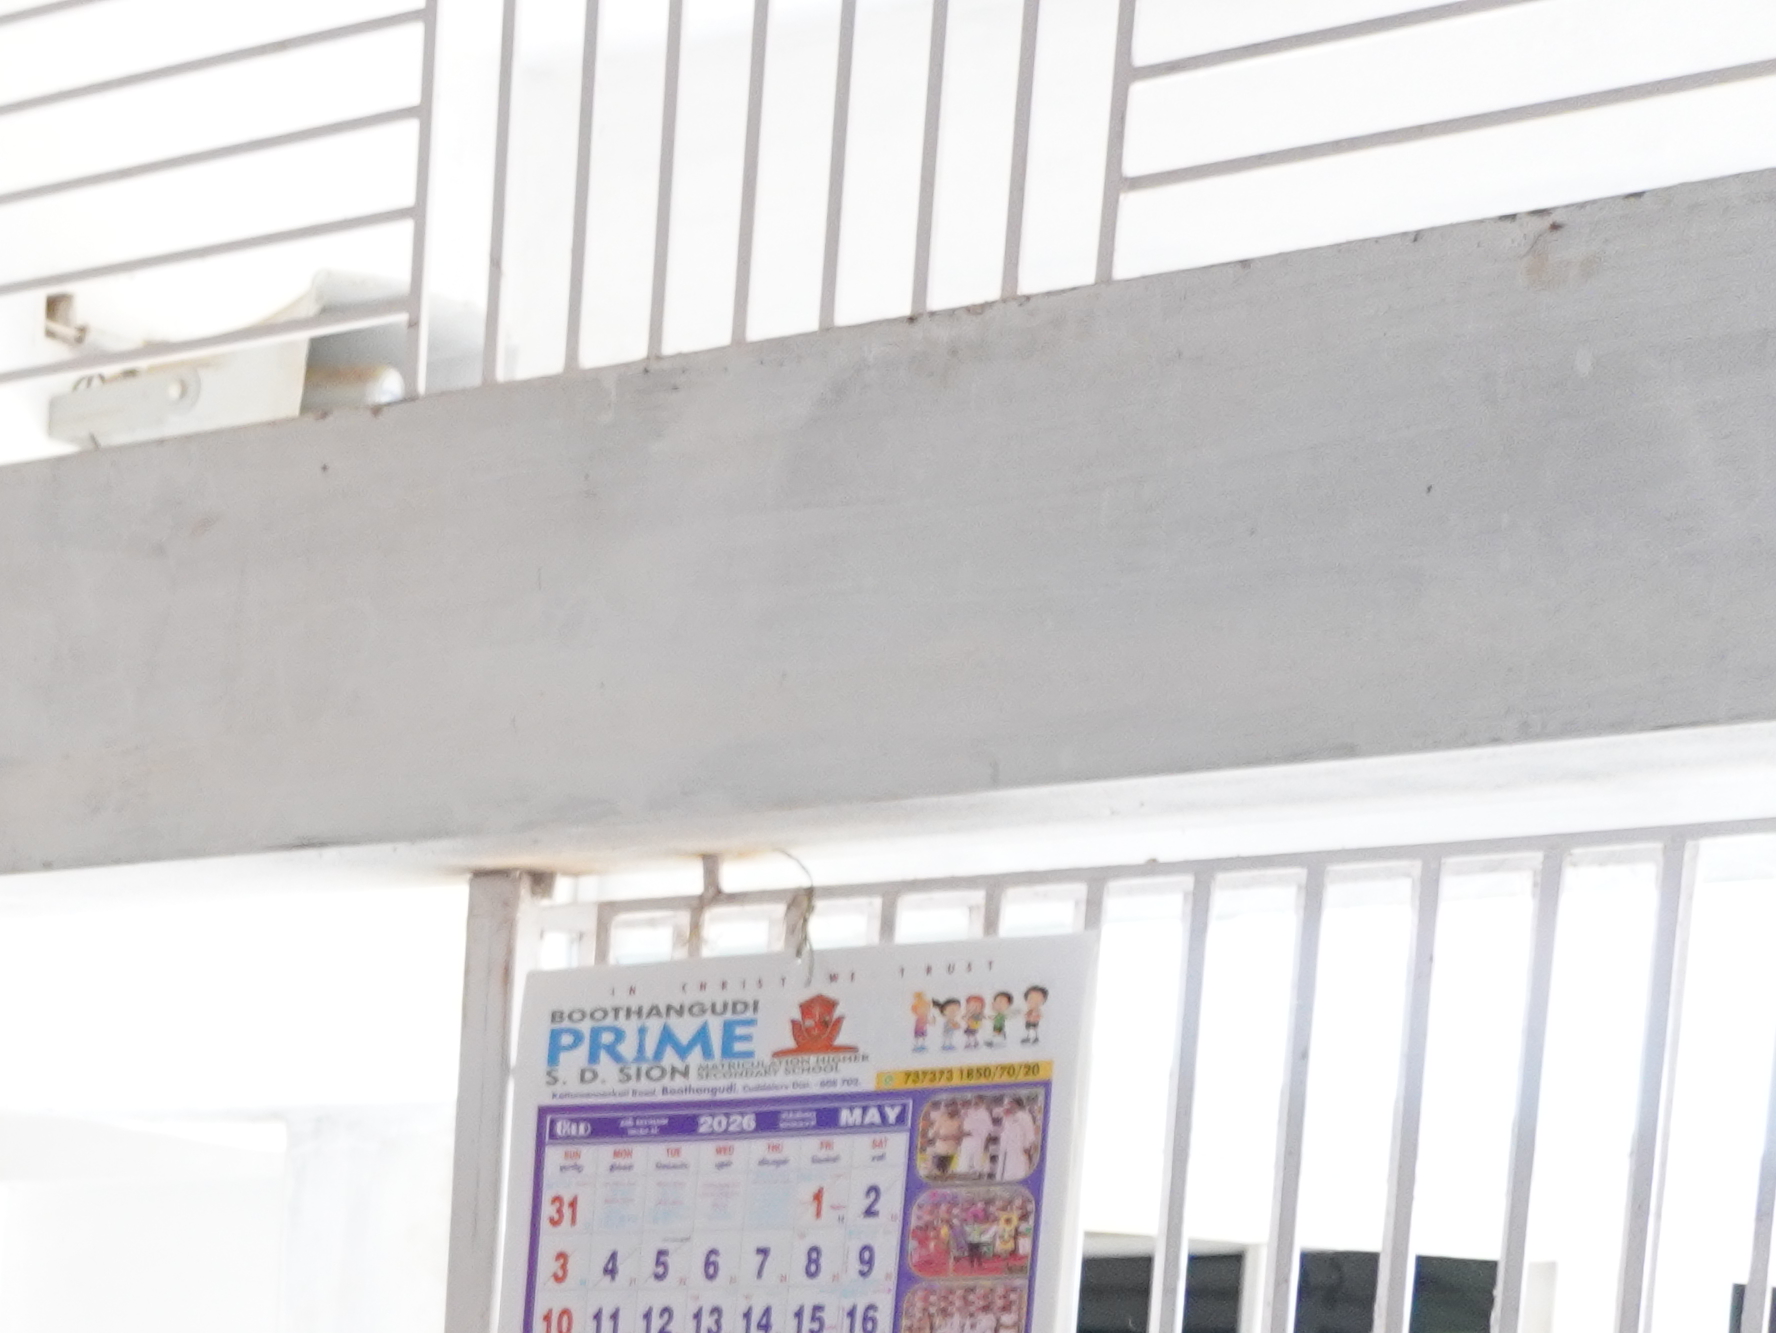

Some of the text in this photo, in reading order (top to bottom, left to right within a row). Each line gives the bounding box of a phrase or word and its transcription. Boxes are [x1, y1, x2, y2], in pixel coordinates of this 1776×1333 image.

[550, 999, 761, 1025] BOOTHANGUDI
[546, 1017, 759, 1068] PRIME
[618, 1063, 691, 1084] SION
[783, 1063, 841, 1076] SCHOOL
[697, 1112, 758, 1135] 2026
[839, 1103, 903, 1128] MAY
[549, 1194, 579, 1228] 31
[812, 1186, 825, 1220] 1
[862, 1184, 882, 1219] 2
[552, 1243, 876, 1284] 3 4 5 6 7 8 9
